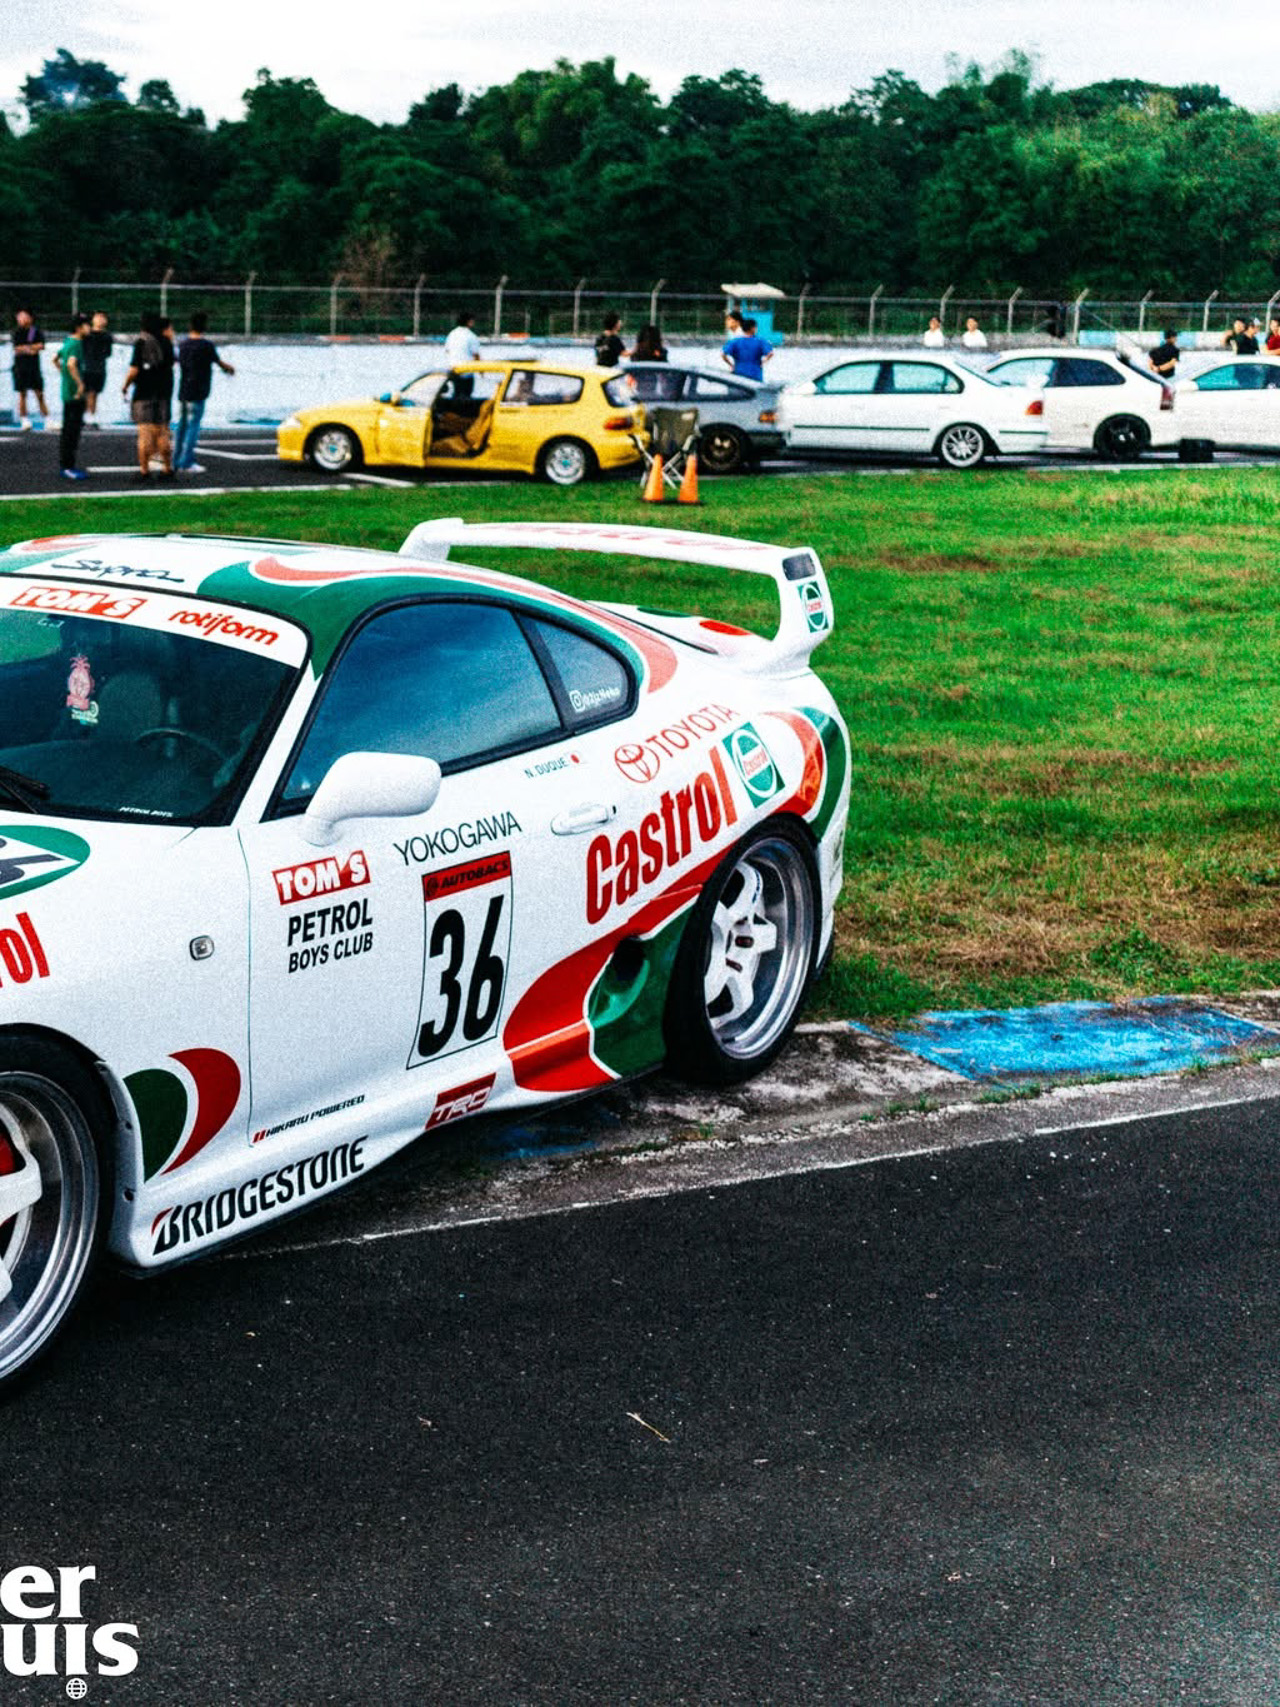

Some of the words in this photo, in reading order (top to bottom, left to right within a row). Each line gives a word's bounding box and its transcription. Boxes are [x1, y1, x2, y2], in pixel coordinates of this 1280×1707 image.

[50, 558, 185, 583] Supra
[13, 587, 144, 618] TOM'S
[167, 609, 279, 646] rotiform
[646, 703, 740, 758] TOYOTA
[392, 811, 523, 866] YOKOGAWA
[586, 746, 738, 925] Castrol
[276, 852, 368, 902] TOM'S
[441, 860, 509, 889] AUTOBACS
[287, 898, 373, 947] PETROL
[288, 944, 329, 974] BOYS
[334, 931, 374, 960] CLUB
[417, 894, 505, 1057] 36
[310, 1094, 366, 1120] POWERED
[433, 1087, 491, 1121] TRD
[151, 1135, 369, 1255] BRIDGESTONE
